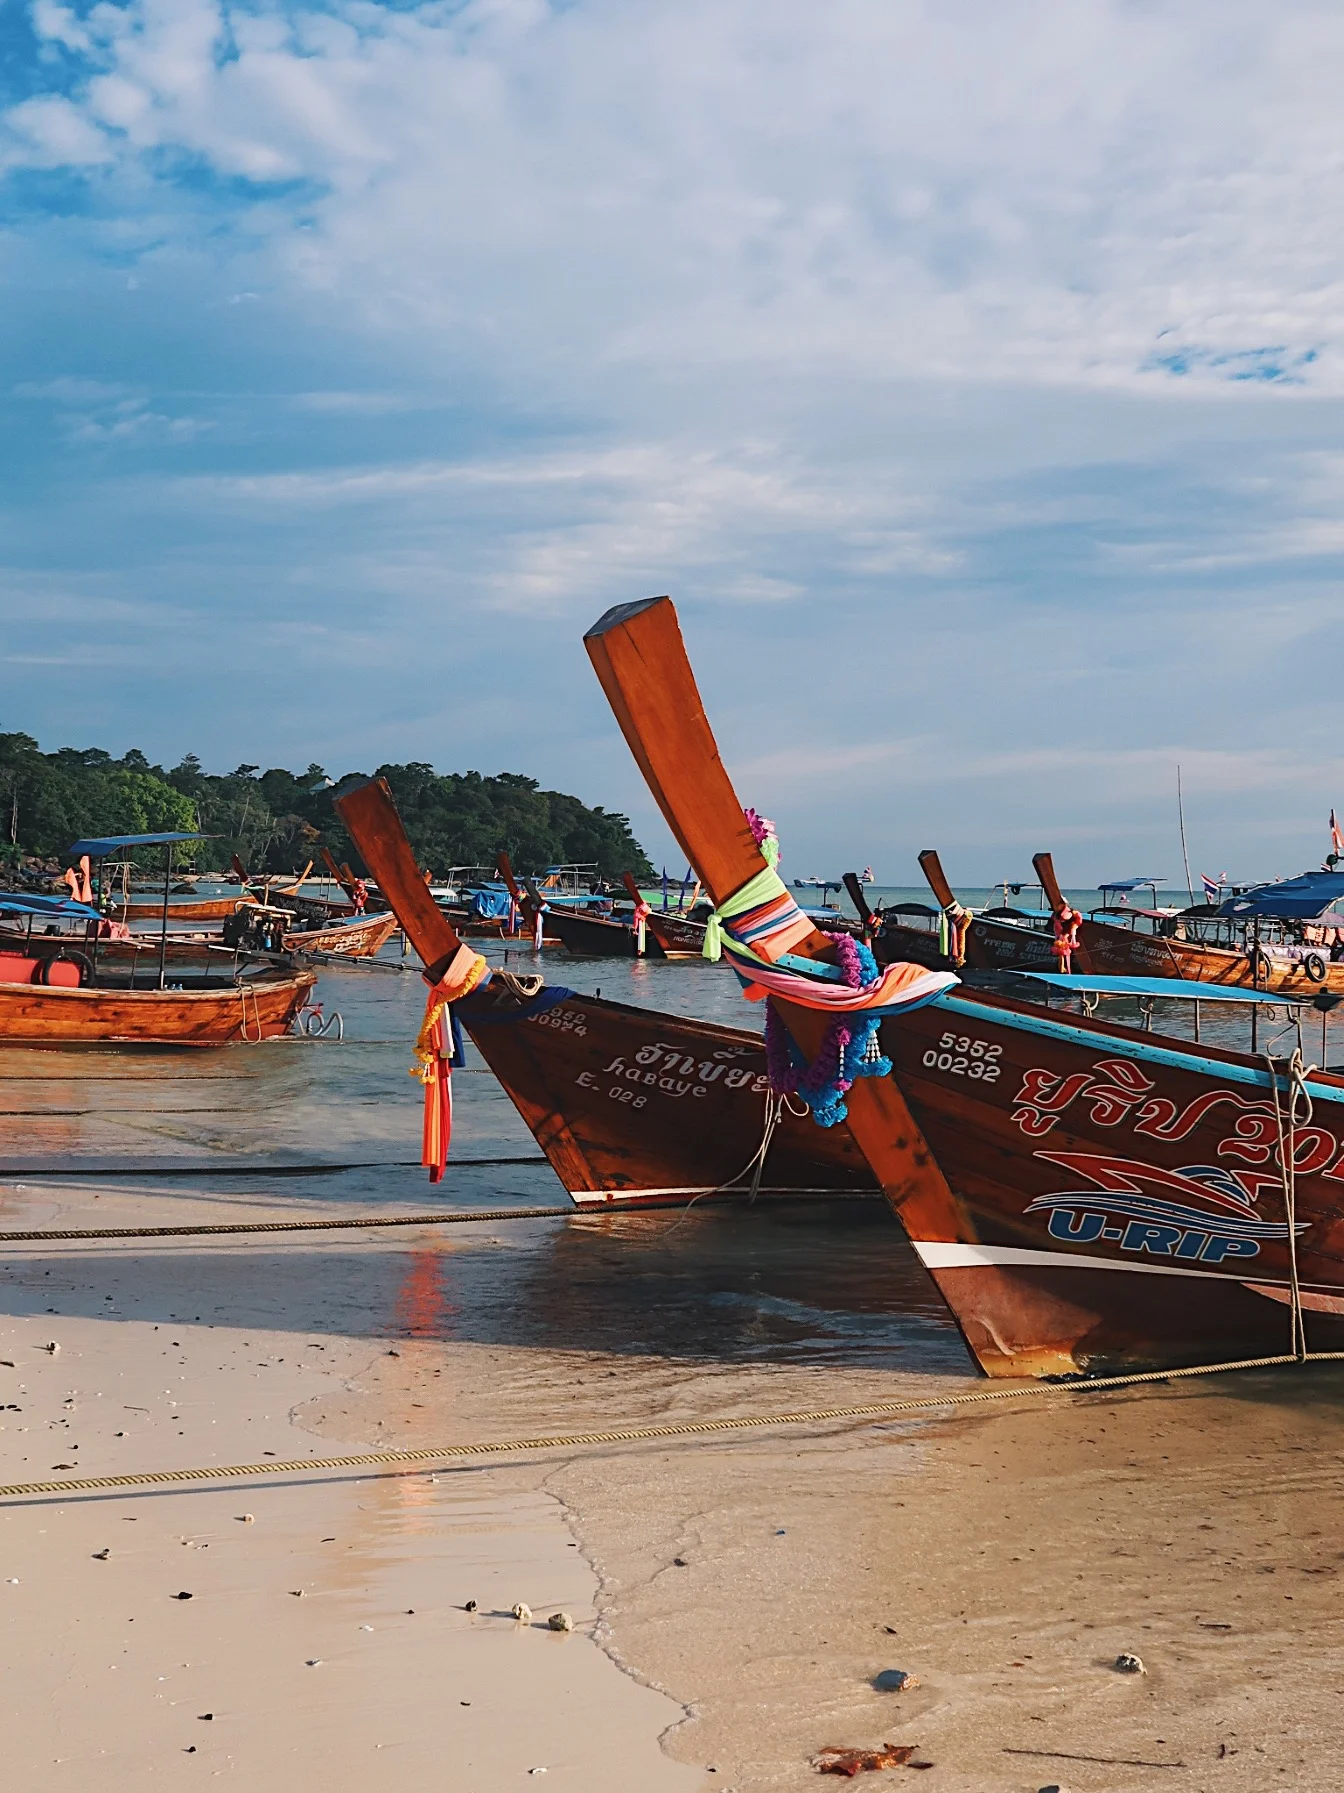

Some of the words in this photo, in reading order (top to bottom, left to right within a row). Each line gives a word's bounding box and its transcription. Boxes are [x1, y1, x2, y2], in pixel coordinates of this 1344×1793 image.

[541, 1007, 587, 1025] 952
[938, 1032, 1004, 1062] 5352
[922, 1050, 1001, 1083] 00232
[608, 1086, 648, 1108] 028
[1047, 1208, 1261, 1263] U-RIP
